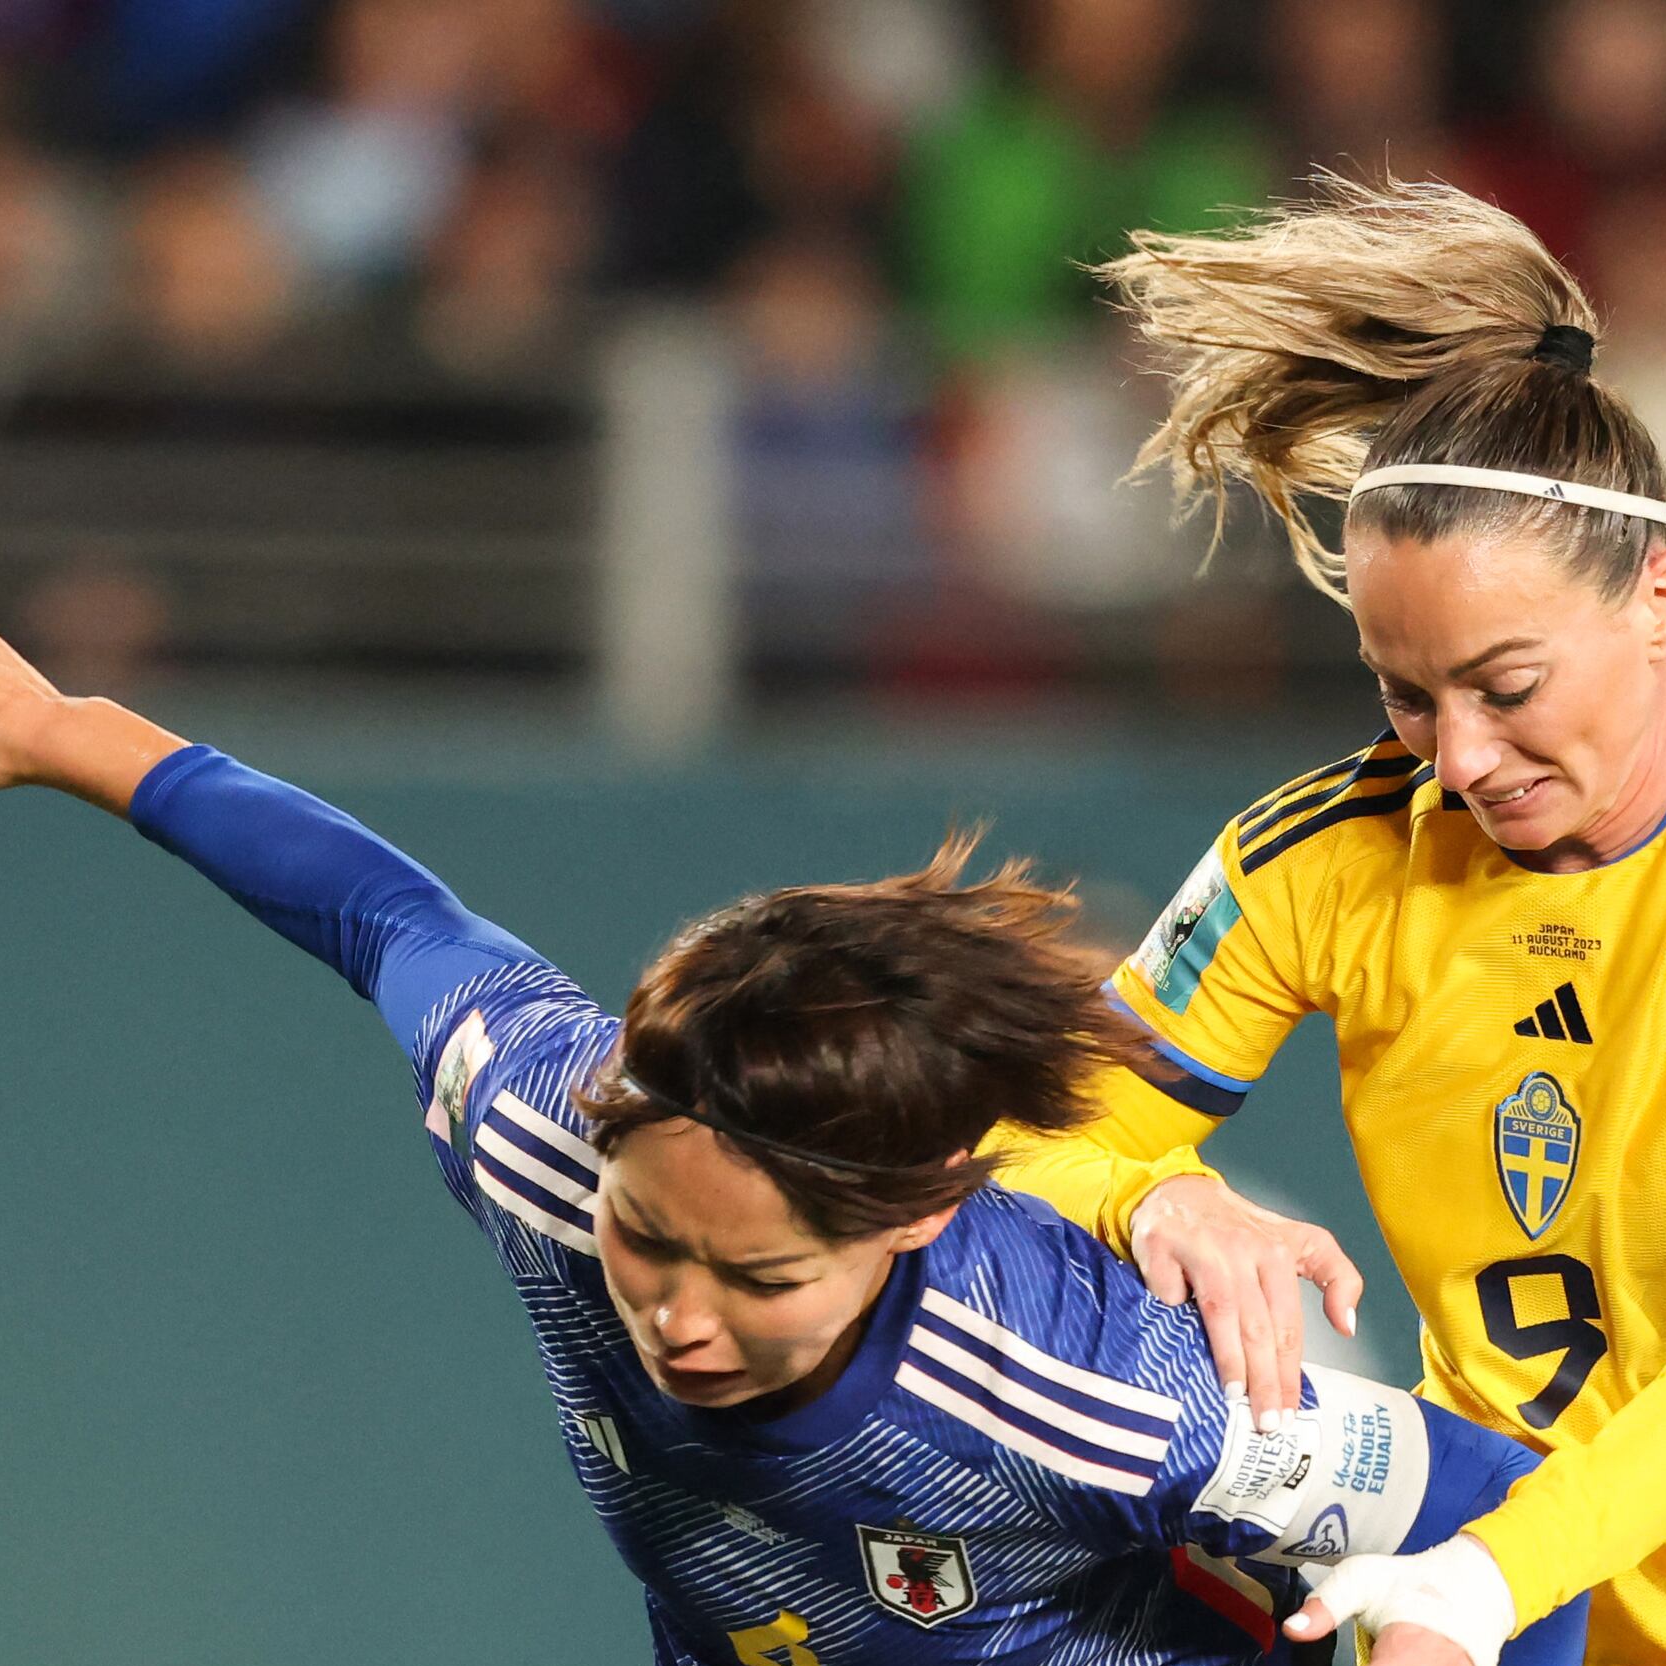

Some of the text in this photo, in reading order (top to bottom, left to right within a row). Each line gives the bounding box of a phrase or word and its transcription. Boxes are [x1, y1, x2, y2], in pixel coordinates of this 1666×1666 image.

[1539, 924, 1575, 936] JAPAN
[1512, 934, 1602, 950] 11 AUGUST 2023
[1529, 945, 1586, 960] AUCKLAND
[1511, 1120, 1565, 1139] SVERIGE
[1475, 1254, 1609, 1430] 9
[1351, 1412, 1376, 1493] GENDER
[1367, 1403, 1392, 1495] EQUALITY
[1333, 1438, 1356, 1488] Unite
[883, 1533, 938, 1547] JAPAN
